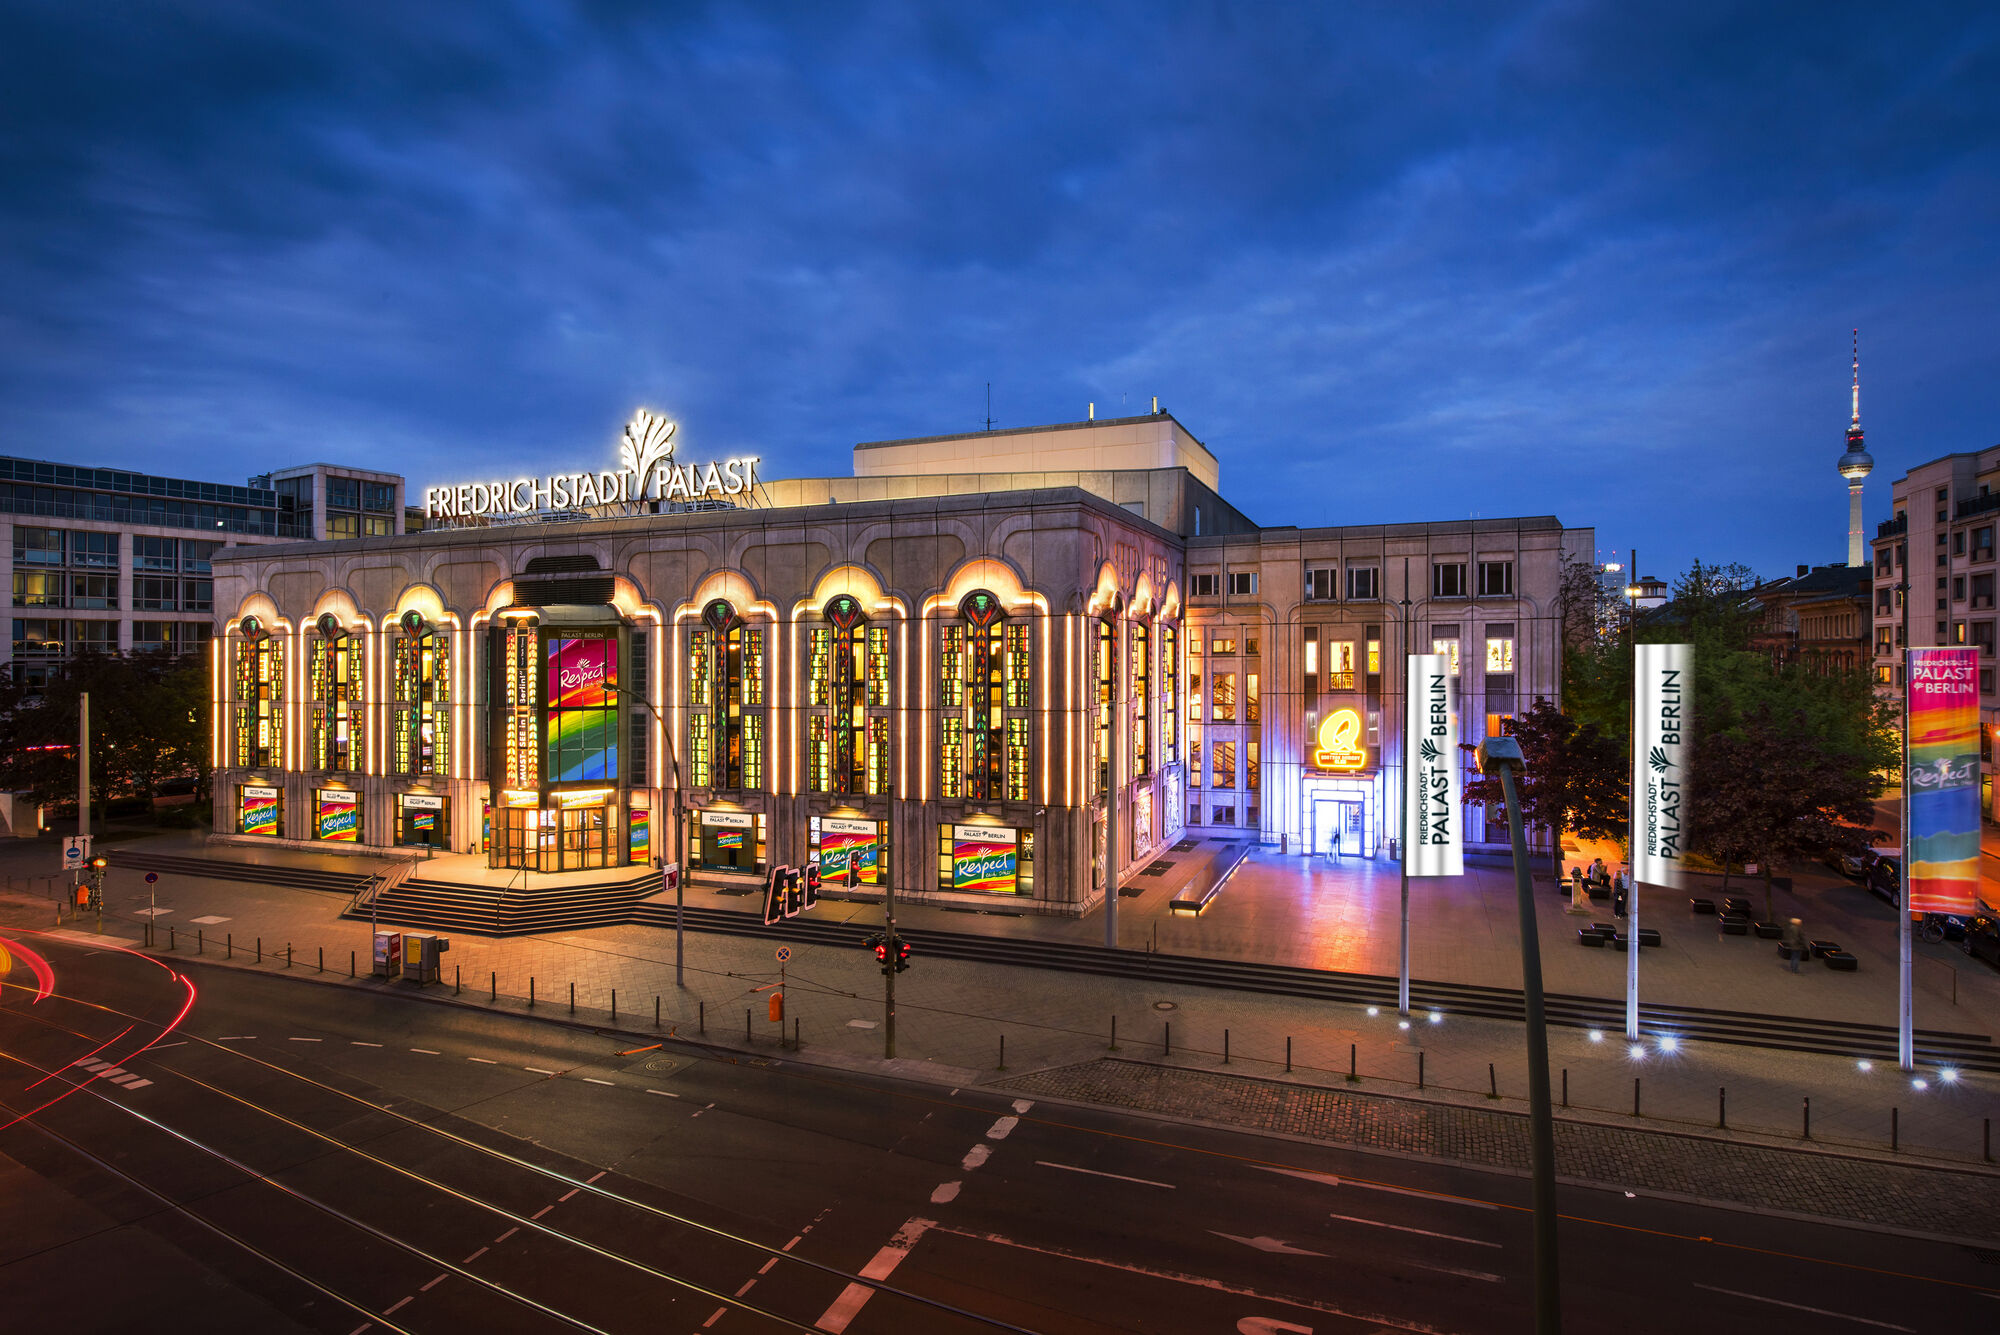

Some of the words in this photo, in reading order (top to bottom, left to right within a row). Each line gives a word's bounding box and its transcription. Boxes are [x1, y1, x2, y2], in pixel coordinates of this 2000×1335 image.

[426, 469, 634, 518] FRIEDRICHSTADT
[655, 457, 760, 499] PALAST
[560, 661, 605, 689] Respect
[1913, 667, 1974, 680] PALAST
[1925, 682, 1974, 694] BERLIN
[1430, 674, 1447, 736] BERLIN
[1661, 670, 1681, 745] BERLIN
[1911, 761, 1977, 788] Respect
[246, 805, 275, 825] Respect
[1419, 766, 1428, 845] FRIEDRICHSTADT-
[1431, 766, 1449, 845] PALAST
[1648, 776, 1657, 856] FRIEDRICHSTADT-
[1660, 777, 1681, 860] PALAST
[323, 810, 354, 832] Respect
[823, 842, 873, 870] Respt
[956, 852, 1014, 879] Respect
